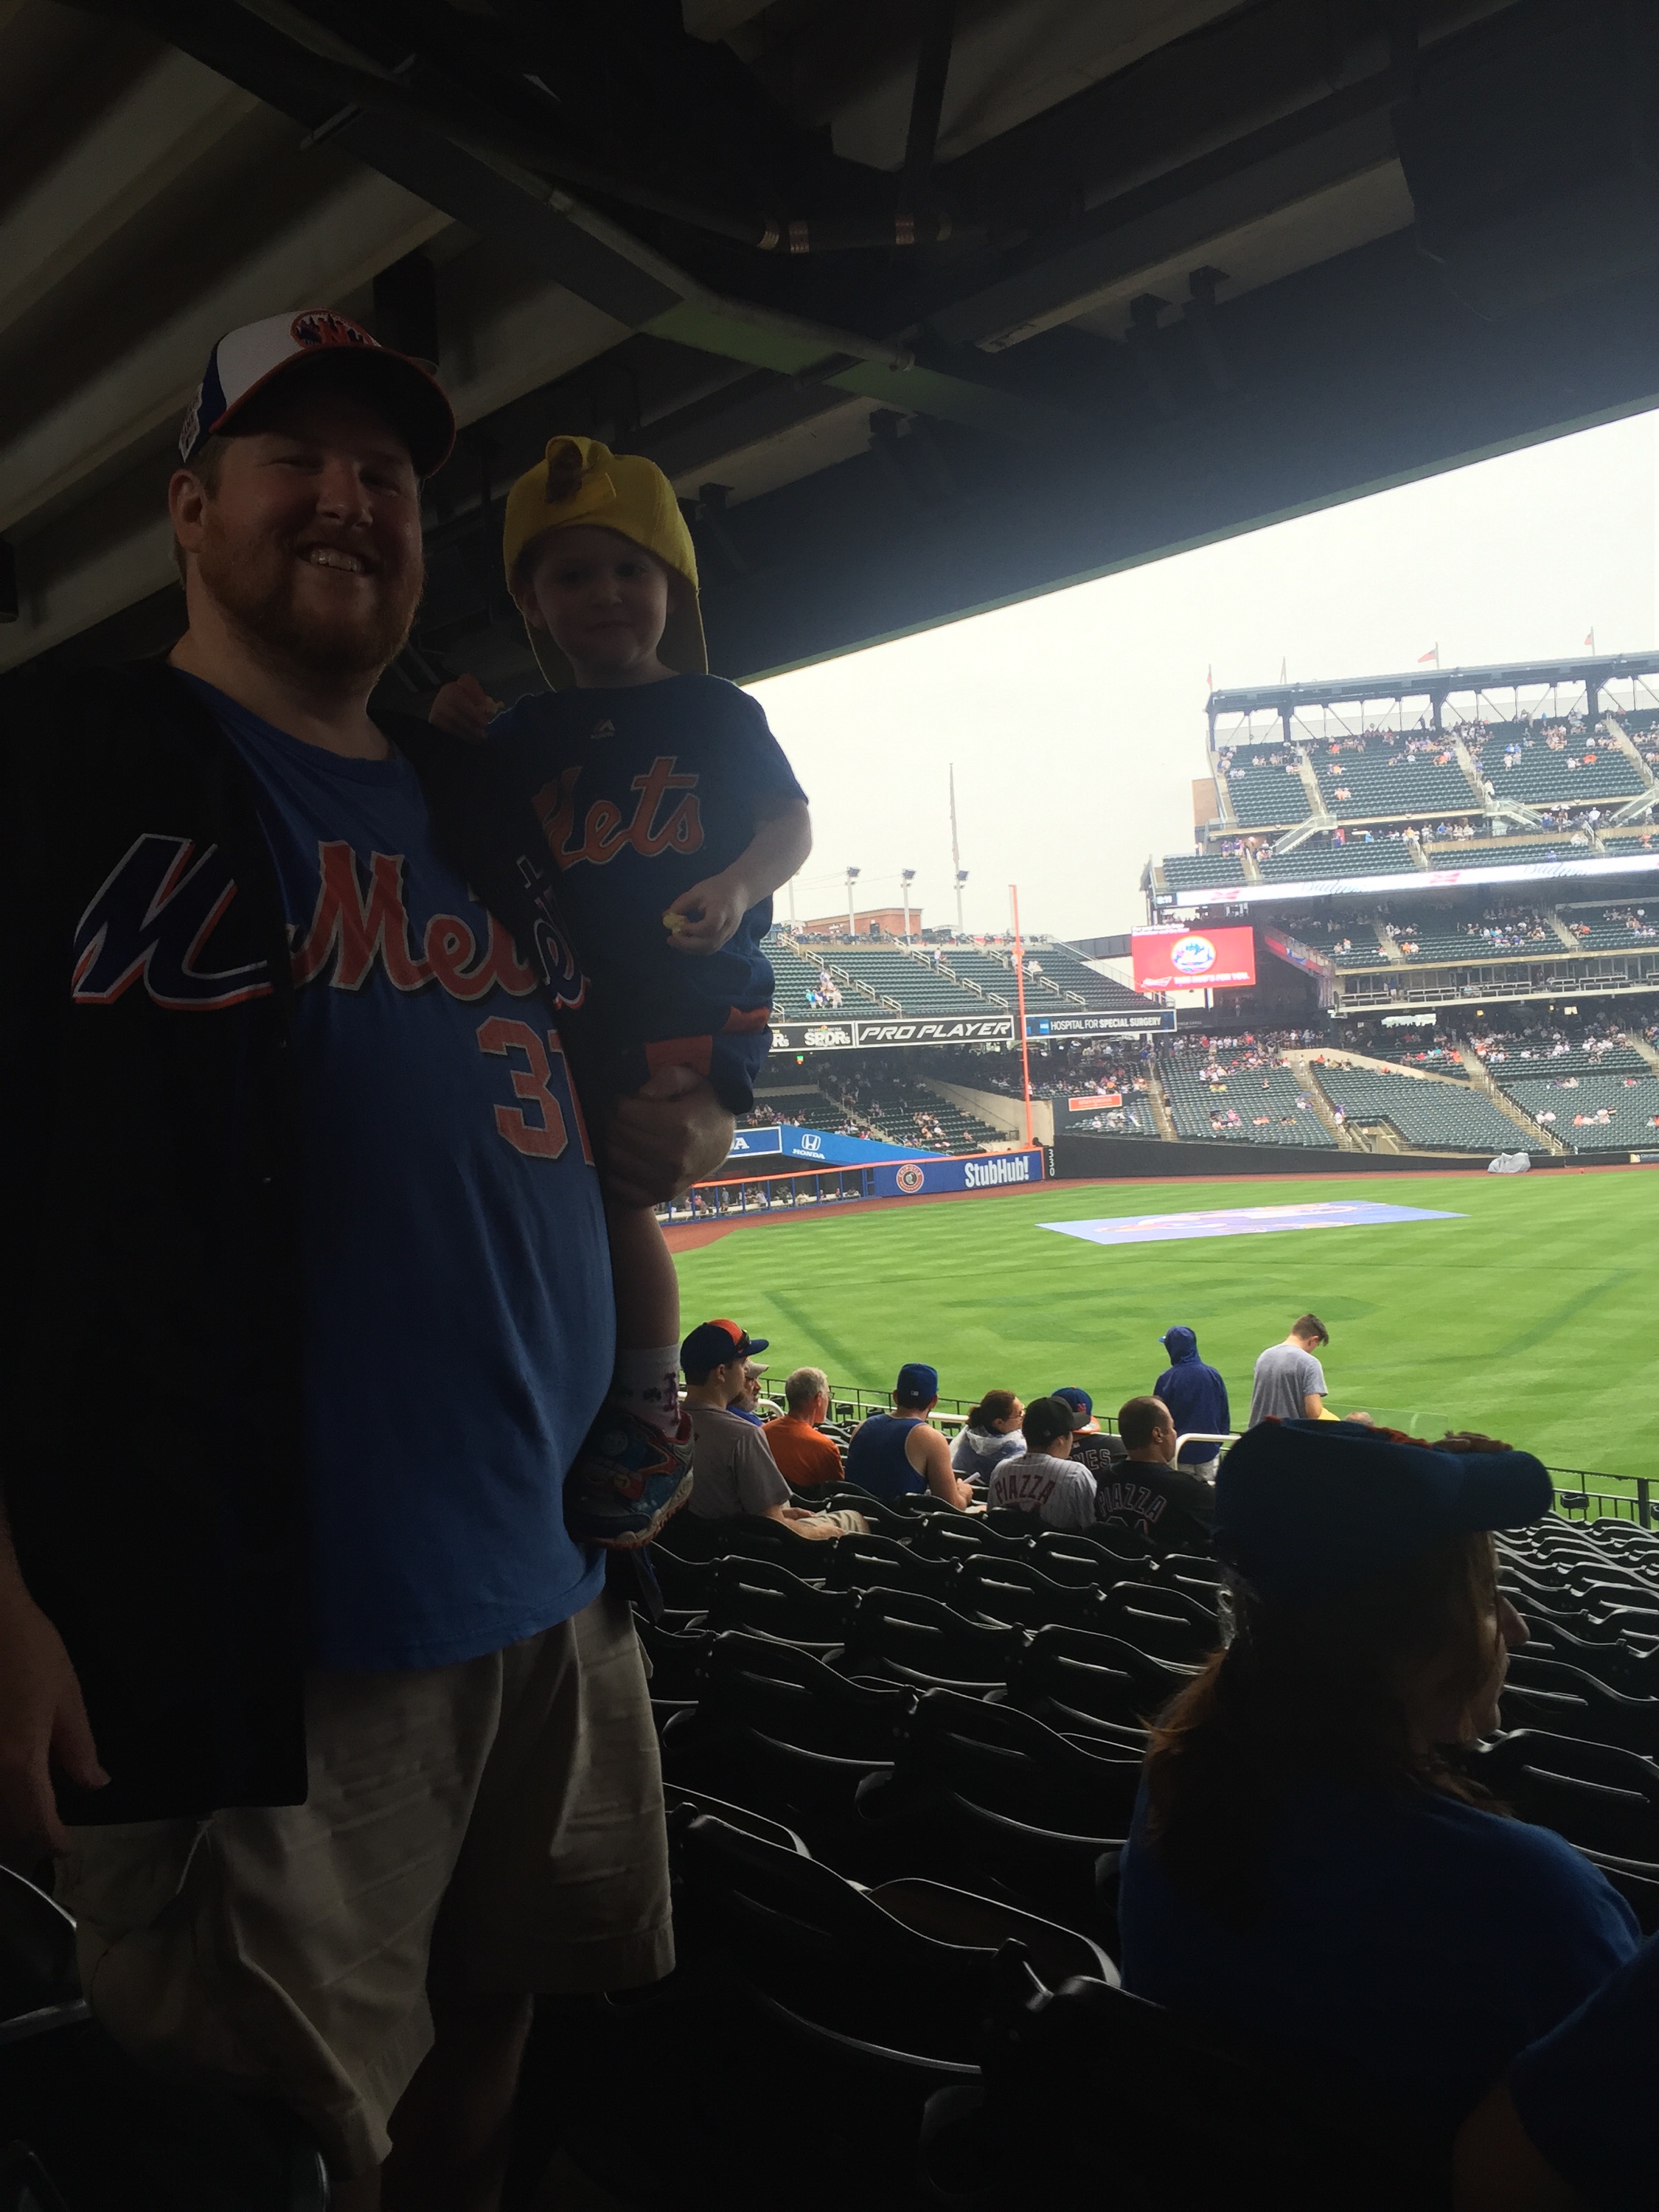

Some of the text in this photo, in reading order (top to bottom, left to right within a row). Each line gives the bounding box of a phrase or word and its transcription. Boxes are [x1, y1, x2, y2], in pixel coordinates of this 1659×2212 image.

[859, 1022, 1011, 1041] PRO PLAYER
[1051, 1020, 1084, 1031] HOSPITAL
[1084, 1019, 1099, 1029] FOR
[1099, 1018, 1129, 1029] SPECIAL
[1130, 1016, 1161, 1027] SURGERY
[792, 1148, 826, 1160] HONDA
[964, 1155, 1029, 1188] StubHub!
[995, 1475, 1056, 1505] PIAZZA
[1099, 1483, 1167, 1523] PIAZZA
